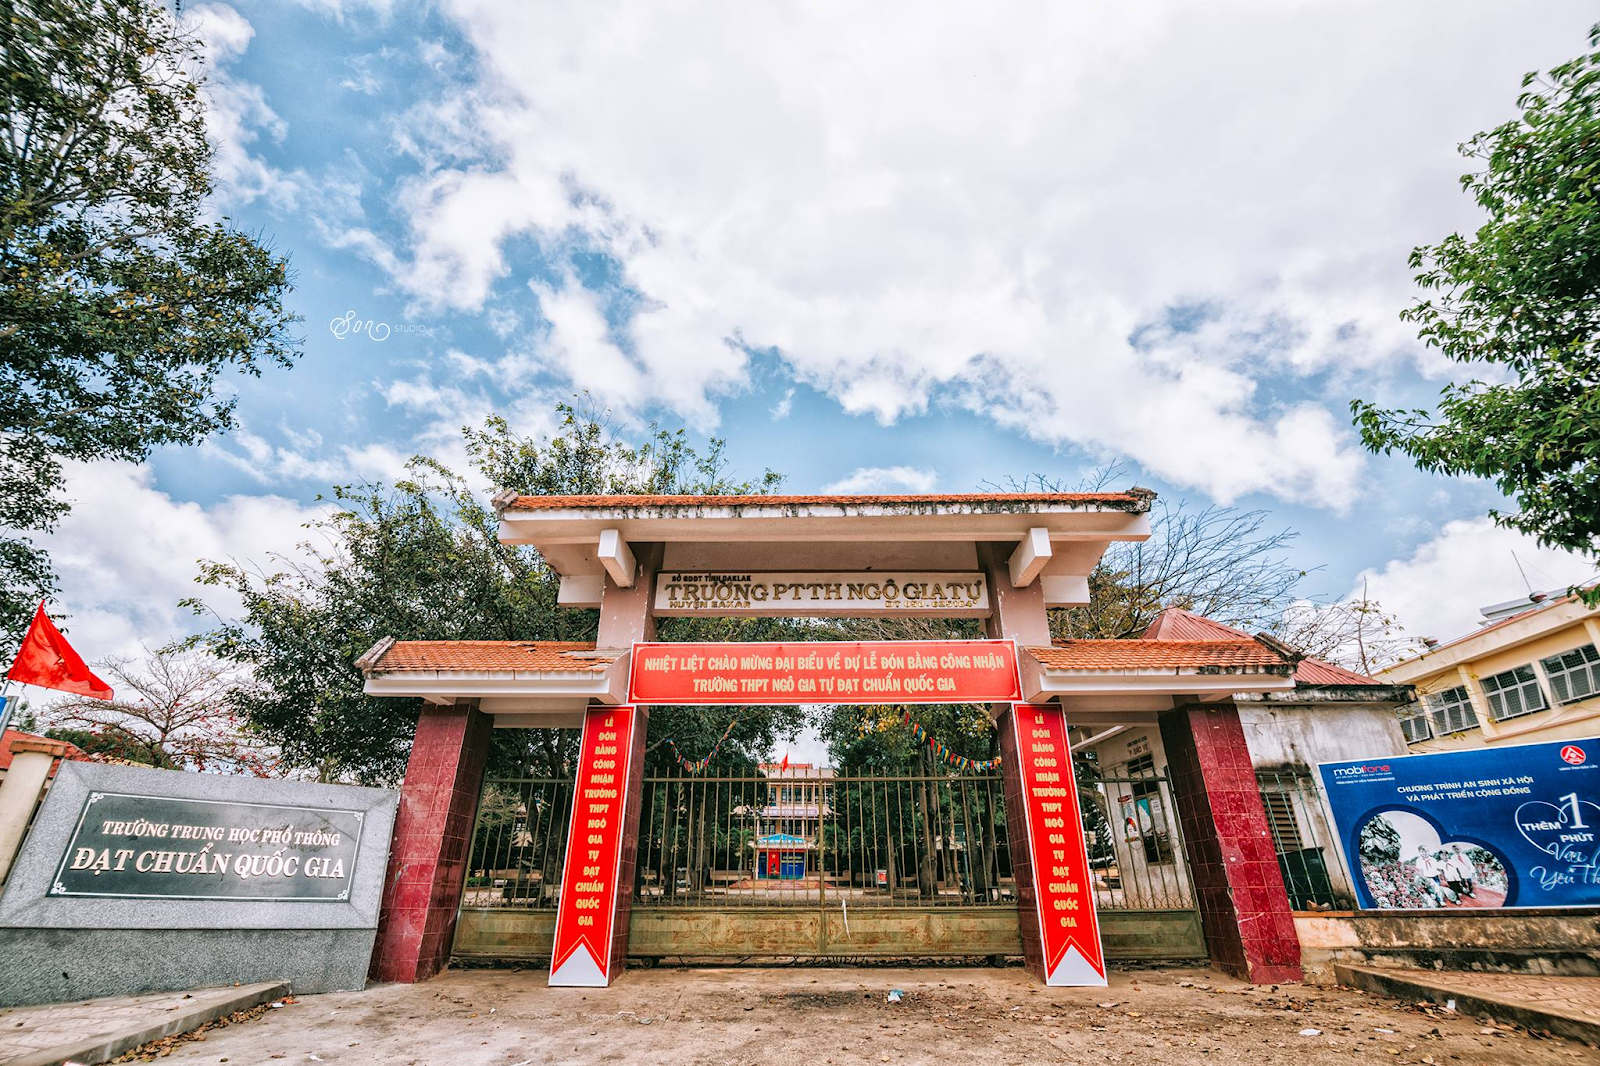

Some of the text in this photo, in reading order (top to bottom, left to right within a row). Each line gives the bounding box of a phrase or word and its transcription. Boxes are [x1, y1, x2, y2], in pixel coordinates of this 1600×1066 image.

[664, 580, 768, 601] TRƯỜNG
[773, 583, 842, 600] PTTH
[846, 578, 900, 600] NGÔ
[670, 599, 707, 609] HUYỆN
[645, 651, 1004, 673] NHIỆT LIỆT CHÀO MỪNG ĐẠI BIỂU VỀ DỰ LỄ ĐÓN BẰNG CÔNG NHẬN
[693, 672, 956, 694] TRƯỜNG THPT NGÔ GIA TỰ ĐẠT CHUẨN QUỐC GIA
[599, 732, 617, 741] ĐÓN
[1032, 729, 1050, 738] ĐÓN
[593, 759, 616, 769] CÔNG
[1034, 756, 1057, 767] CÔNG
[1333, 765, 1390, 776] mobifone
[591, 773, 614, 785] NHẬN
[1036, 771, 1059, 784] NHẬN
[1434, 782, 1461, 791] TRÌNH
[1463, 781, 1477, 789] AN
[1478, 778, 1501, 787] SINH
[1516, 775, 1534, 785] HỘI
[584, 787, 617, 798] TRƯỜNG
[1032, 786, 1067, 797] TRƯỜNG
[1406, 793, 1420, 802] VÀ
[1421, 792, 1444, 801] PHÁT
[1476, 788, 1502, 798] CỘNG
[589, 804, 609, 813] THPT
[1041, 802, 1062, 812] THPT
[1521, 792, 1590, 831] THÊM 1
[588, 817, 607, 829] NGÔ
[1044, 817, 1064, 828] NGÔ
[102, 818, 340, 846] TRƯỜNG TRUNG HỌC PHỔ THÔNG
[1560, 832, 1594, 842] PHÚT
[588, 834, 603, 844] GIA
[1049, 834, 1065, 844] GIA
[70, 842, 345, 879] ĐẠT CHUẨN QUỐC GIA
[583, 866, 600, 878] ĐẠT
[1052, 866, 1069, 878] ĐẠT
[575, 896, 600, 909] QUỐC
[1054, 897, 1079, 910] QUỐC
[578, 916, 593, 926] GIA
[1060, 917, 1077, 927] GIA
